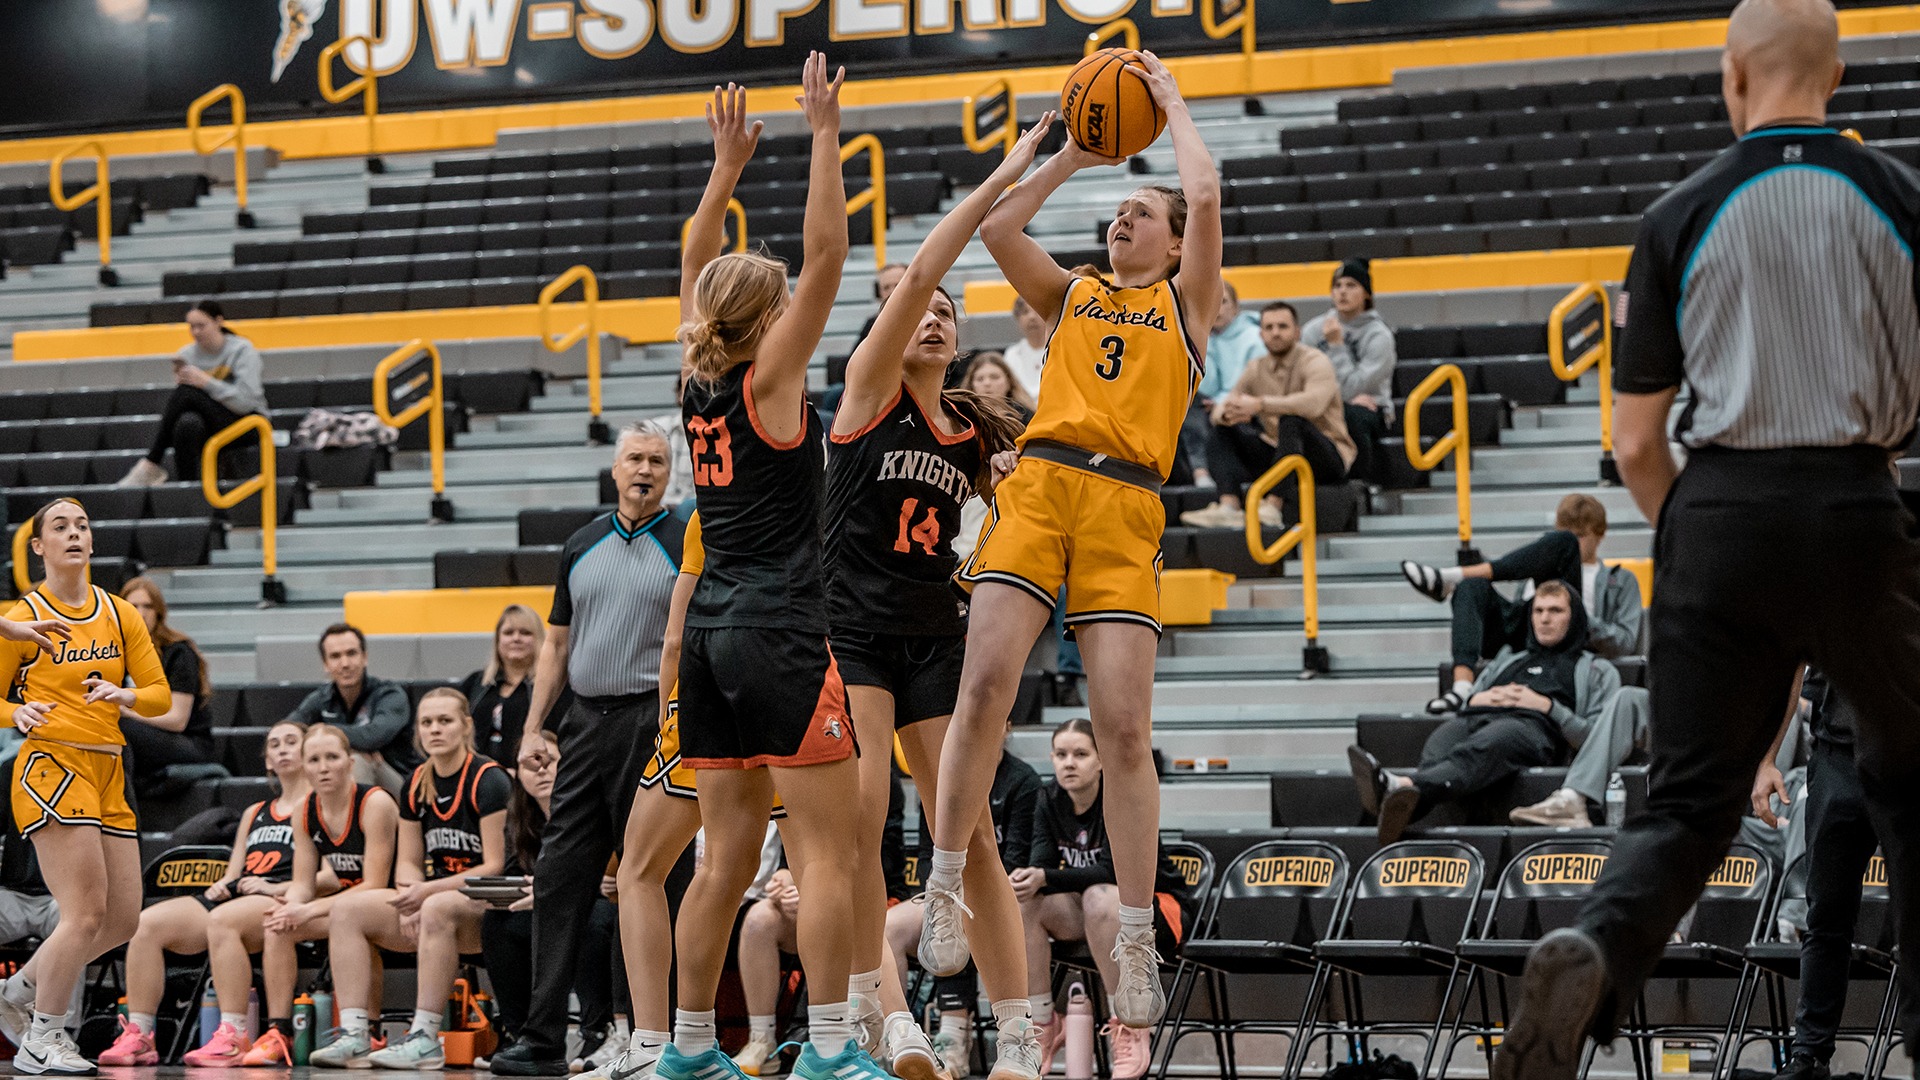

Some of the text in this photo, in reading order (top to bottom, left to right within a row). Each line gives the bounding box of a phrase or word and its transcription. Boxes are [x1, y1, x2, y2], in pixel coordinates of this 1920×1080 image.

[1088, 103, 1106, 150] NCAA
[1073, 296, 1168, 332] Jackets
[1094, 334, 1126, 382] 3
[687, 415, 734, 487] 23
[893, 497, 939, 556] 14
[52, 639, 122, 665] Jackets
[1247, 859, 1331, 884] SUPERIOR
[1382, 860, 1467, 885] SUPERIOR
[1525, 856, 1603, 881] SUPERIO
